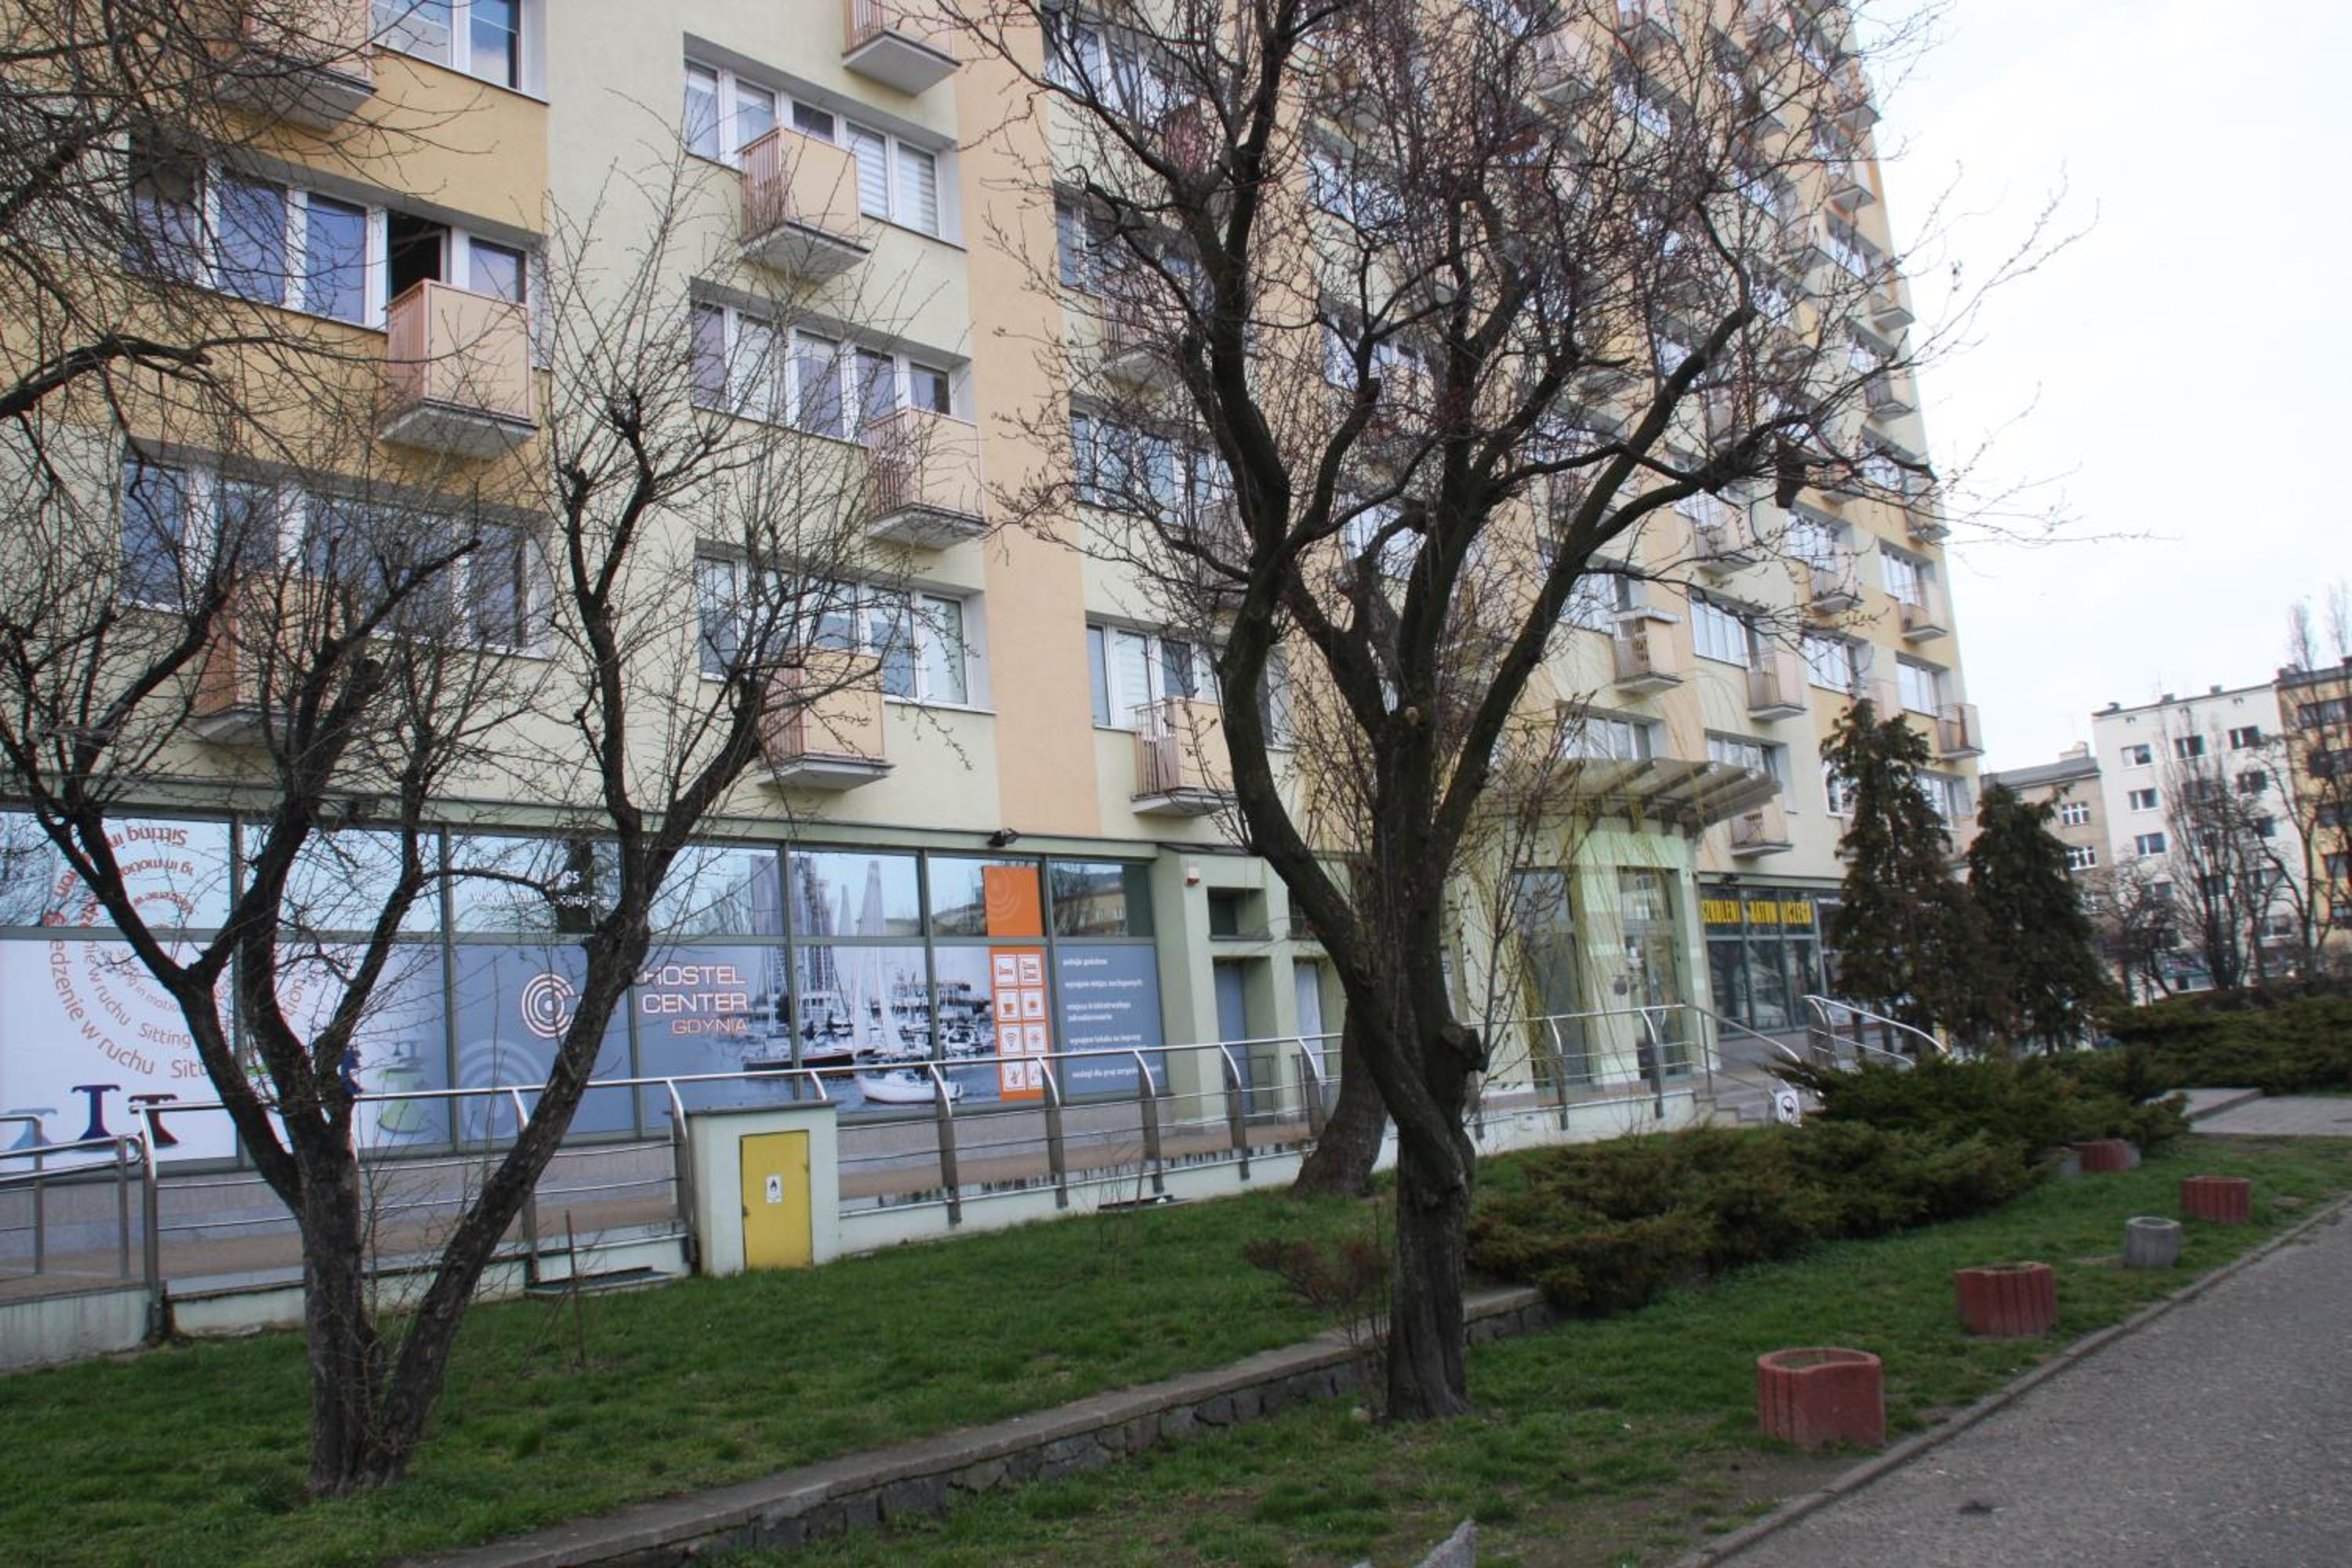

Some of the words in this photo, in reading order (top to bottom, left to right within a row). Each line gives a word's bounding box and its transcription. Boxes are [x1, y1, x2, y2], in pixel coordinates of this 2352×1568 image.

[128, 826, 188, 846] Sitting
[643, 965, 748, 985] HOSTEL
[641, 993, 750, 1014] CENTER
[95, 982, 132, 1027] ruchu
[137, 1022, 191, 1049] Sitting
[672, 1018, 749, 1035] GDYNIA
[81, 1020, 101, 1040] w
[97, 1037, 154, 1076] ruchu
[170, 1059, 209, 1079] Sitt
